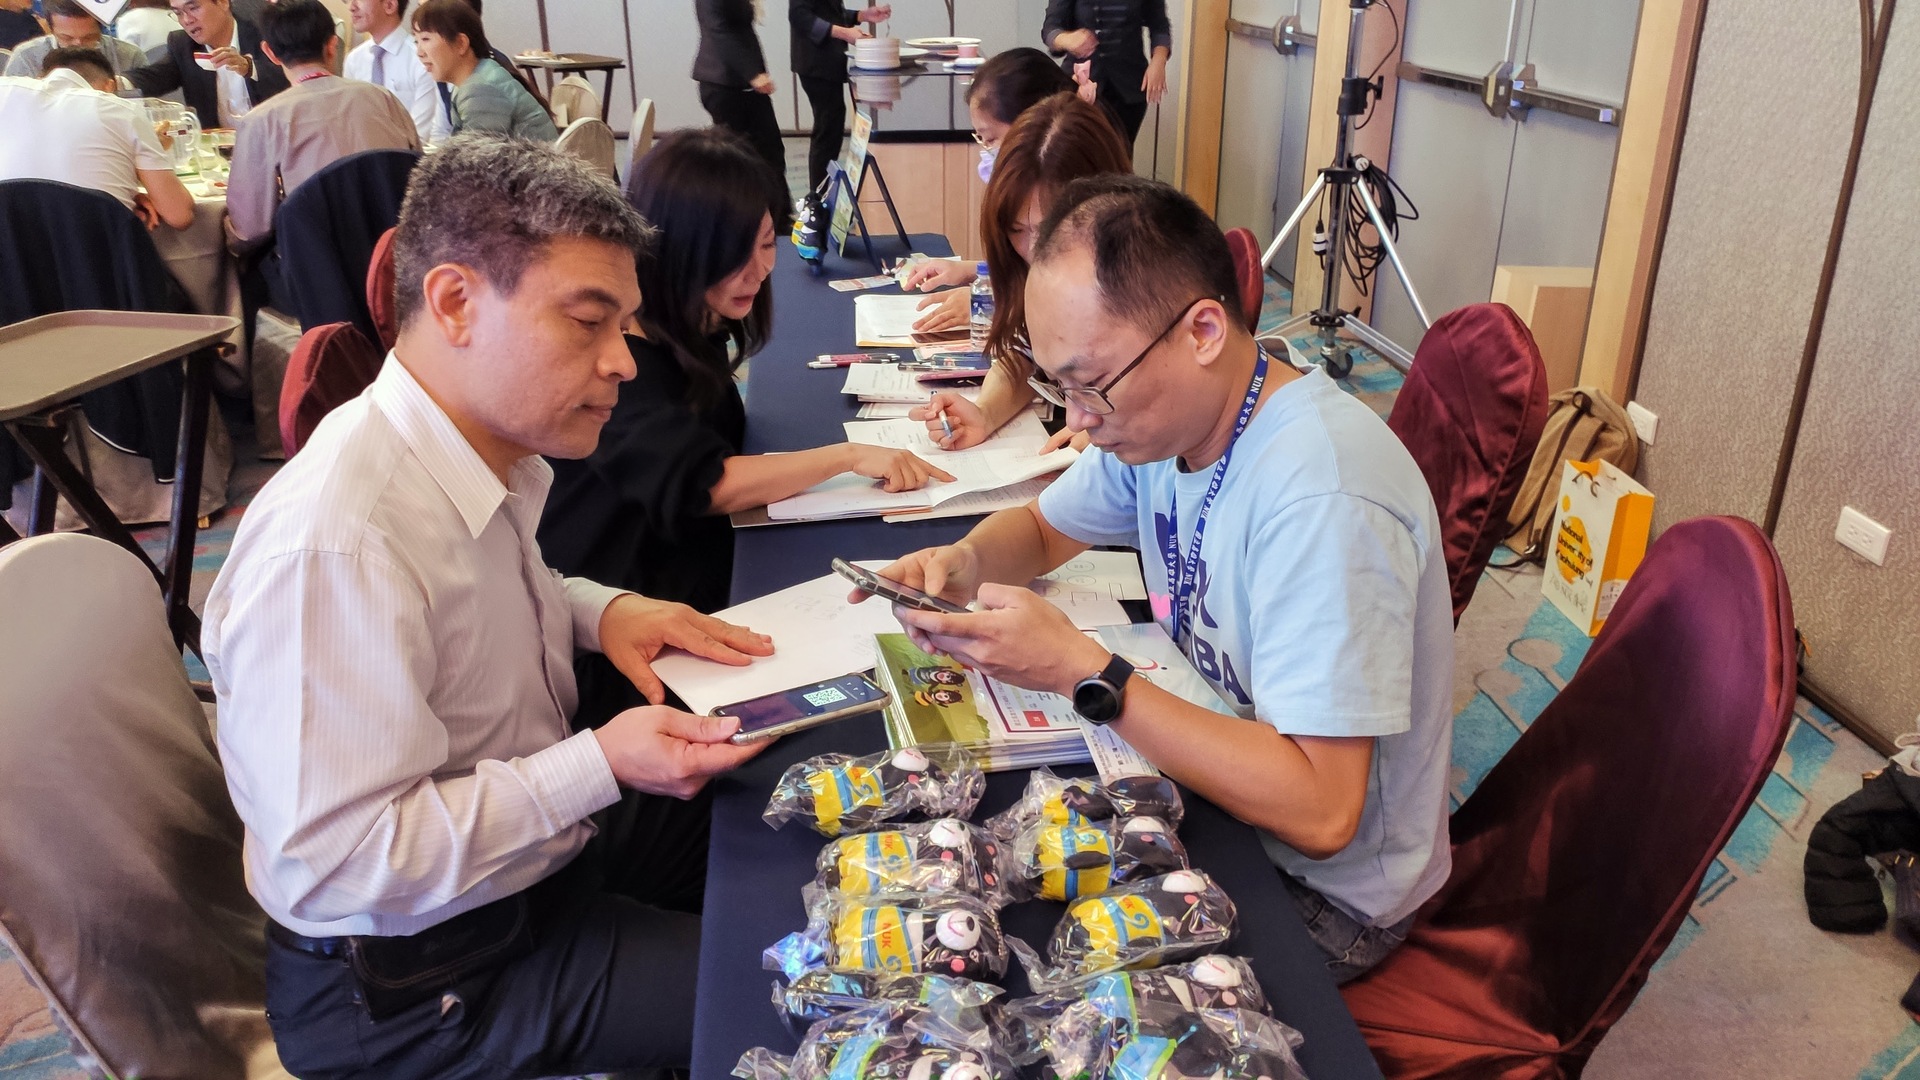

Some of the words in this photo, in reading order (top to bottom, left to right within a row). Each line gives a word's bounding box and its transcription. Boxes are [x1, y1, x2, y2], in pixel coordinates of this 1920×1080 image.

[1250, 375, 1264, 393] NUK
[1168, 533, 1176, 549] NUK
[1558, 533, 1585, 563] Univerity
[1183, 572, 1193, 586] NUK
[881, 922, 892, 949] NUK
